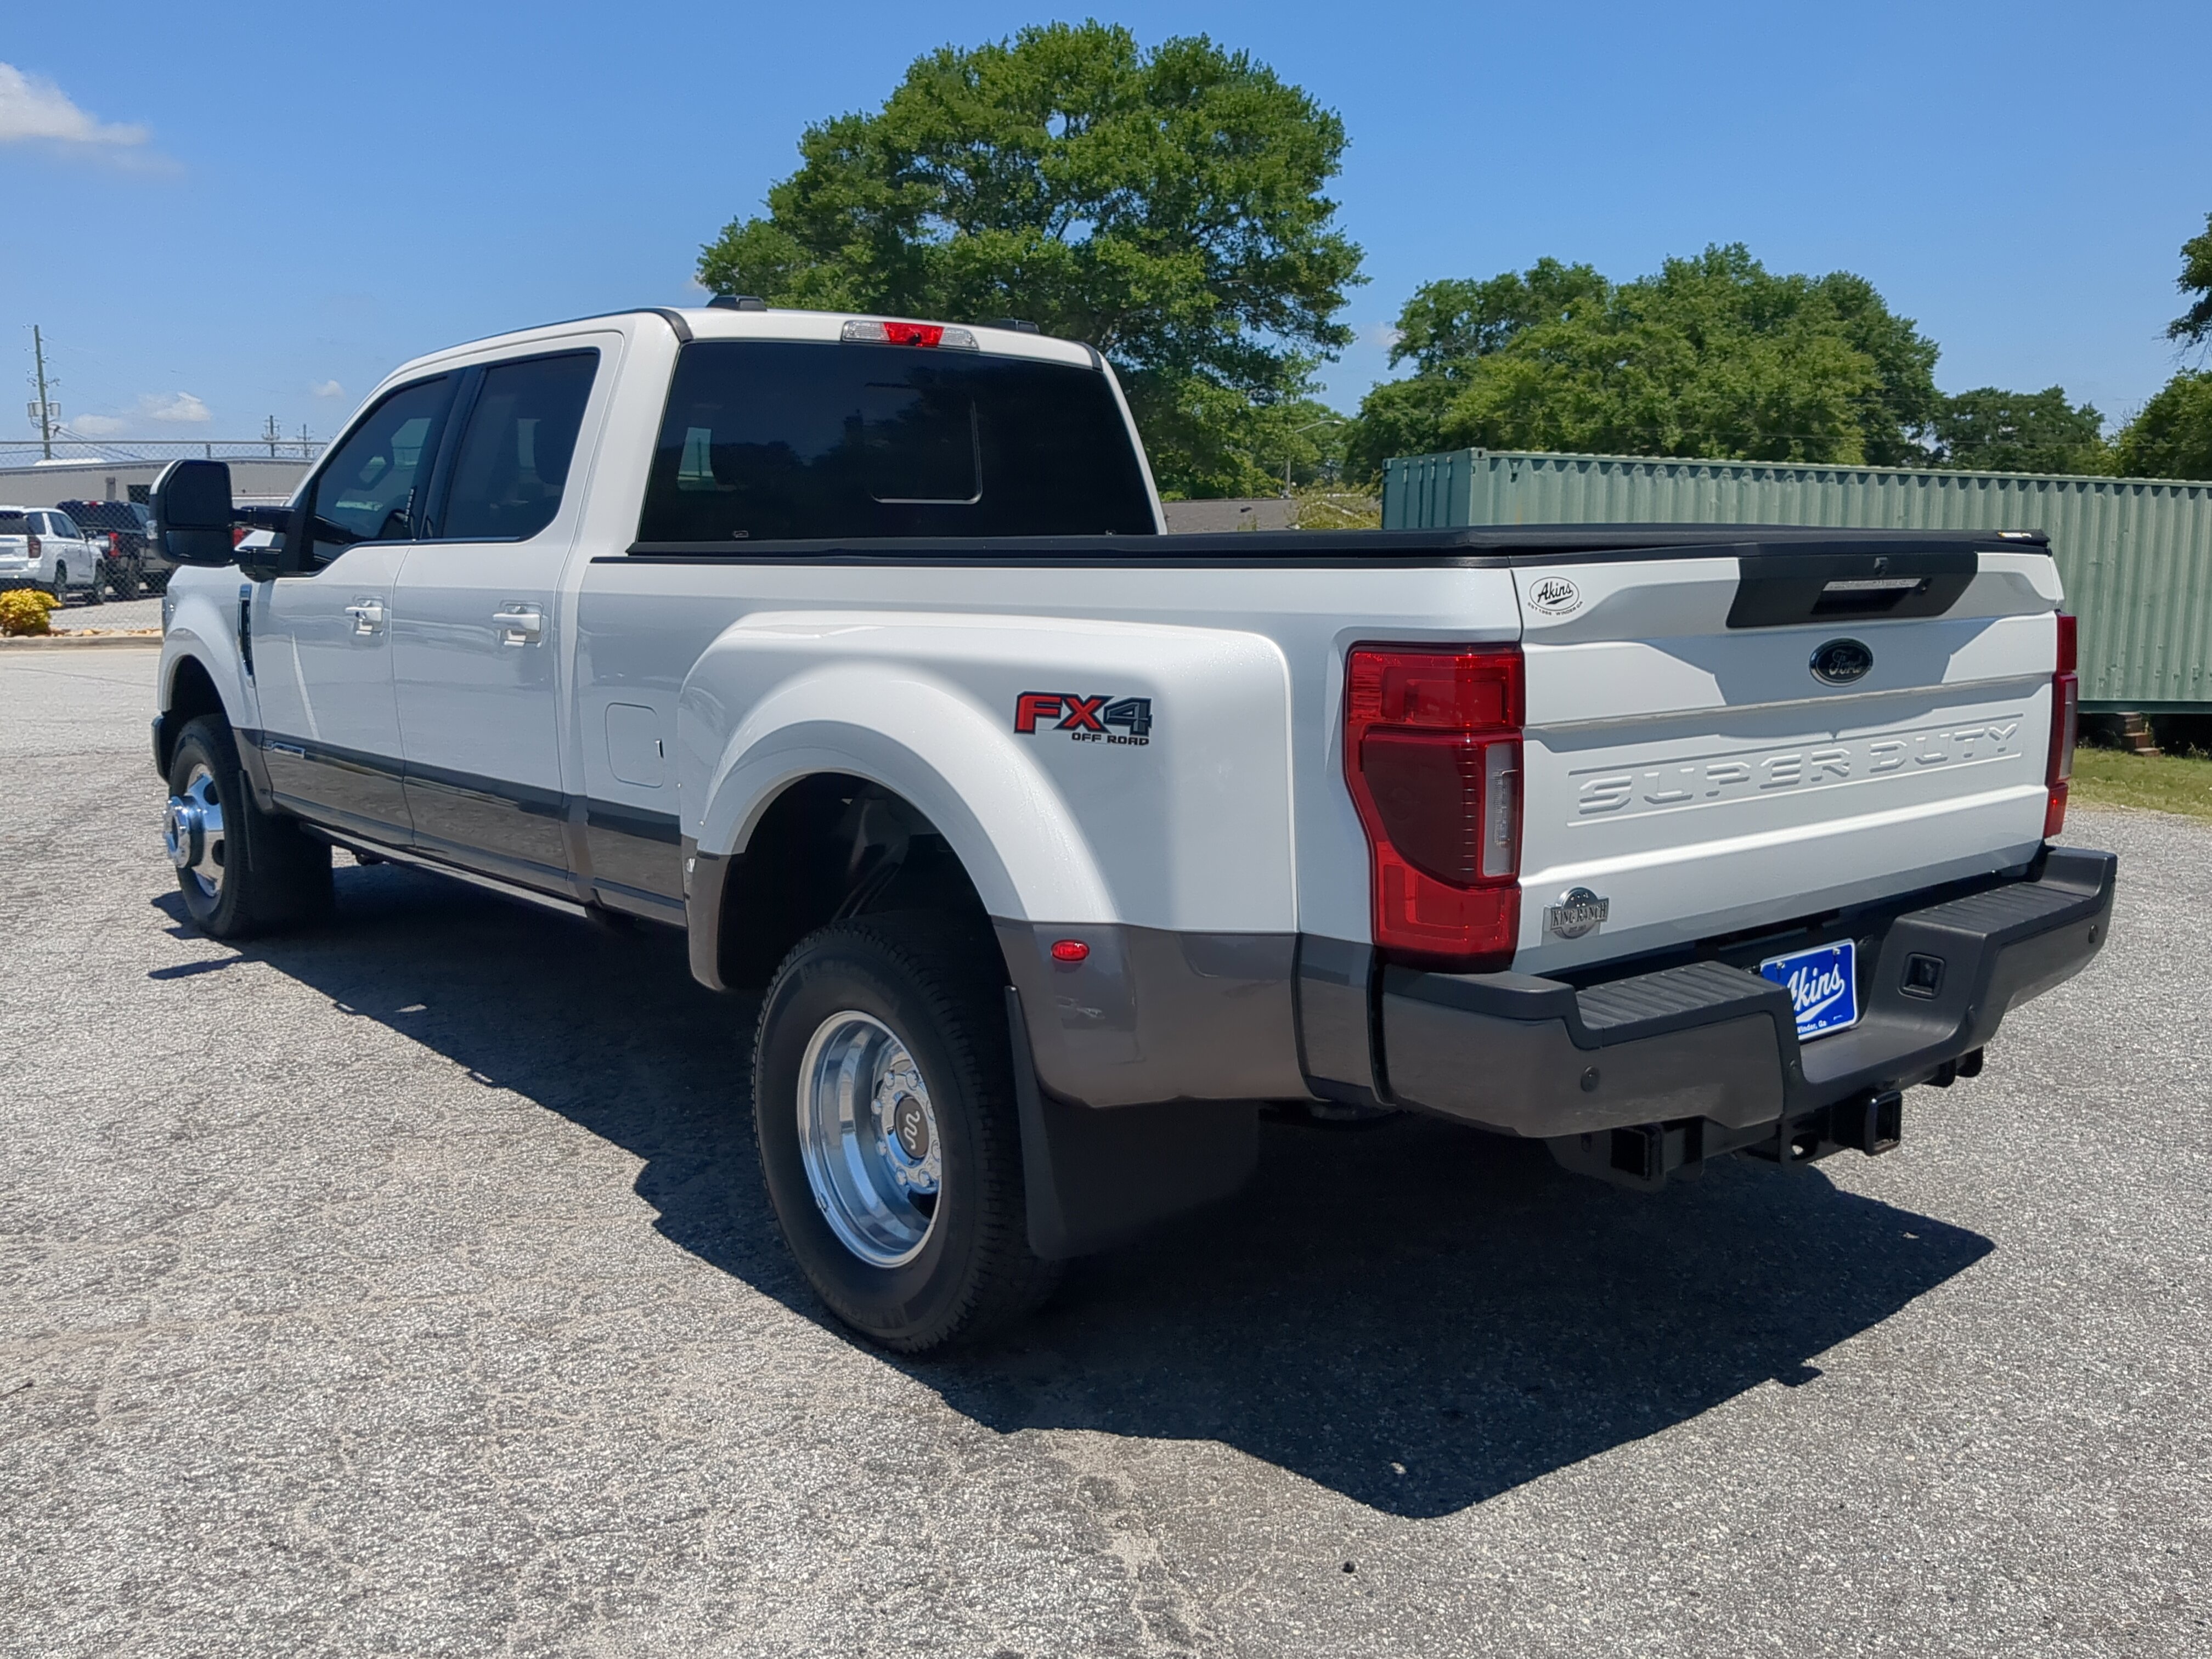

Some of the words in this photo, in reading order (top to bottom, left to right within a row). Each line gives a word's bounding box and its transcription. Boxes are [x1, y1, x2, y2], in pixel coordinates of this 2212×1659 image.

[1537, 581, 1573, 603] Akins
[1555, 606, 1576, 616] WINDER
[1829, 650, 1862, 675] Ford
[1014, 691, 1152, 737] FX4
[1071, 732, 1102, 742] OFF
[1107, 735, 1149, 746] ROAD
[1579, 748, 1850, 815] SUPER
[1869, 724, 2017, 773] DUTY
[1553, 910, 1576, 927] KING
[1577, 902, 1607, 922] RANCH
